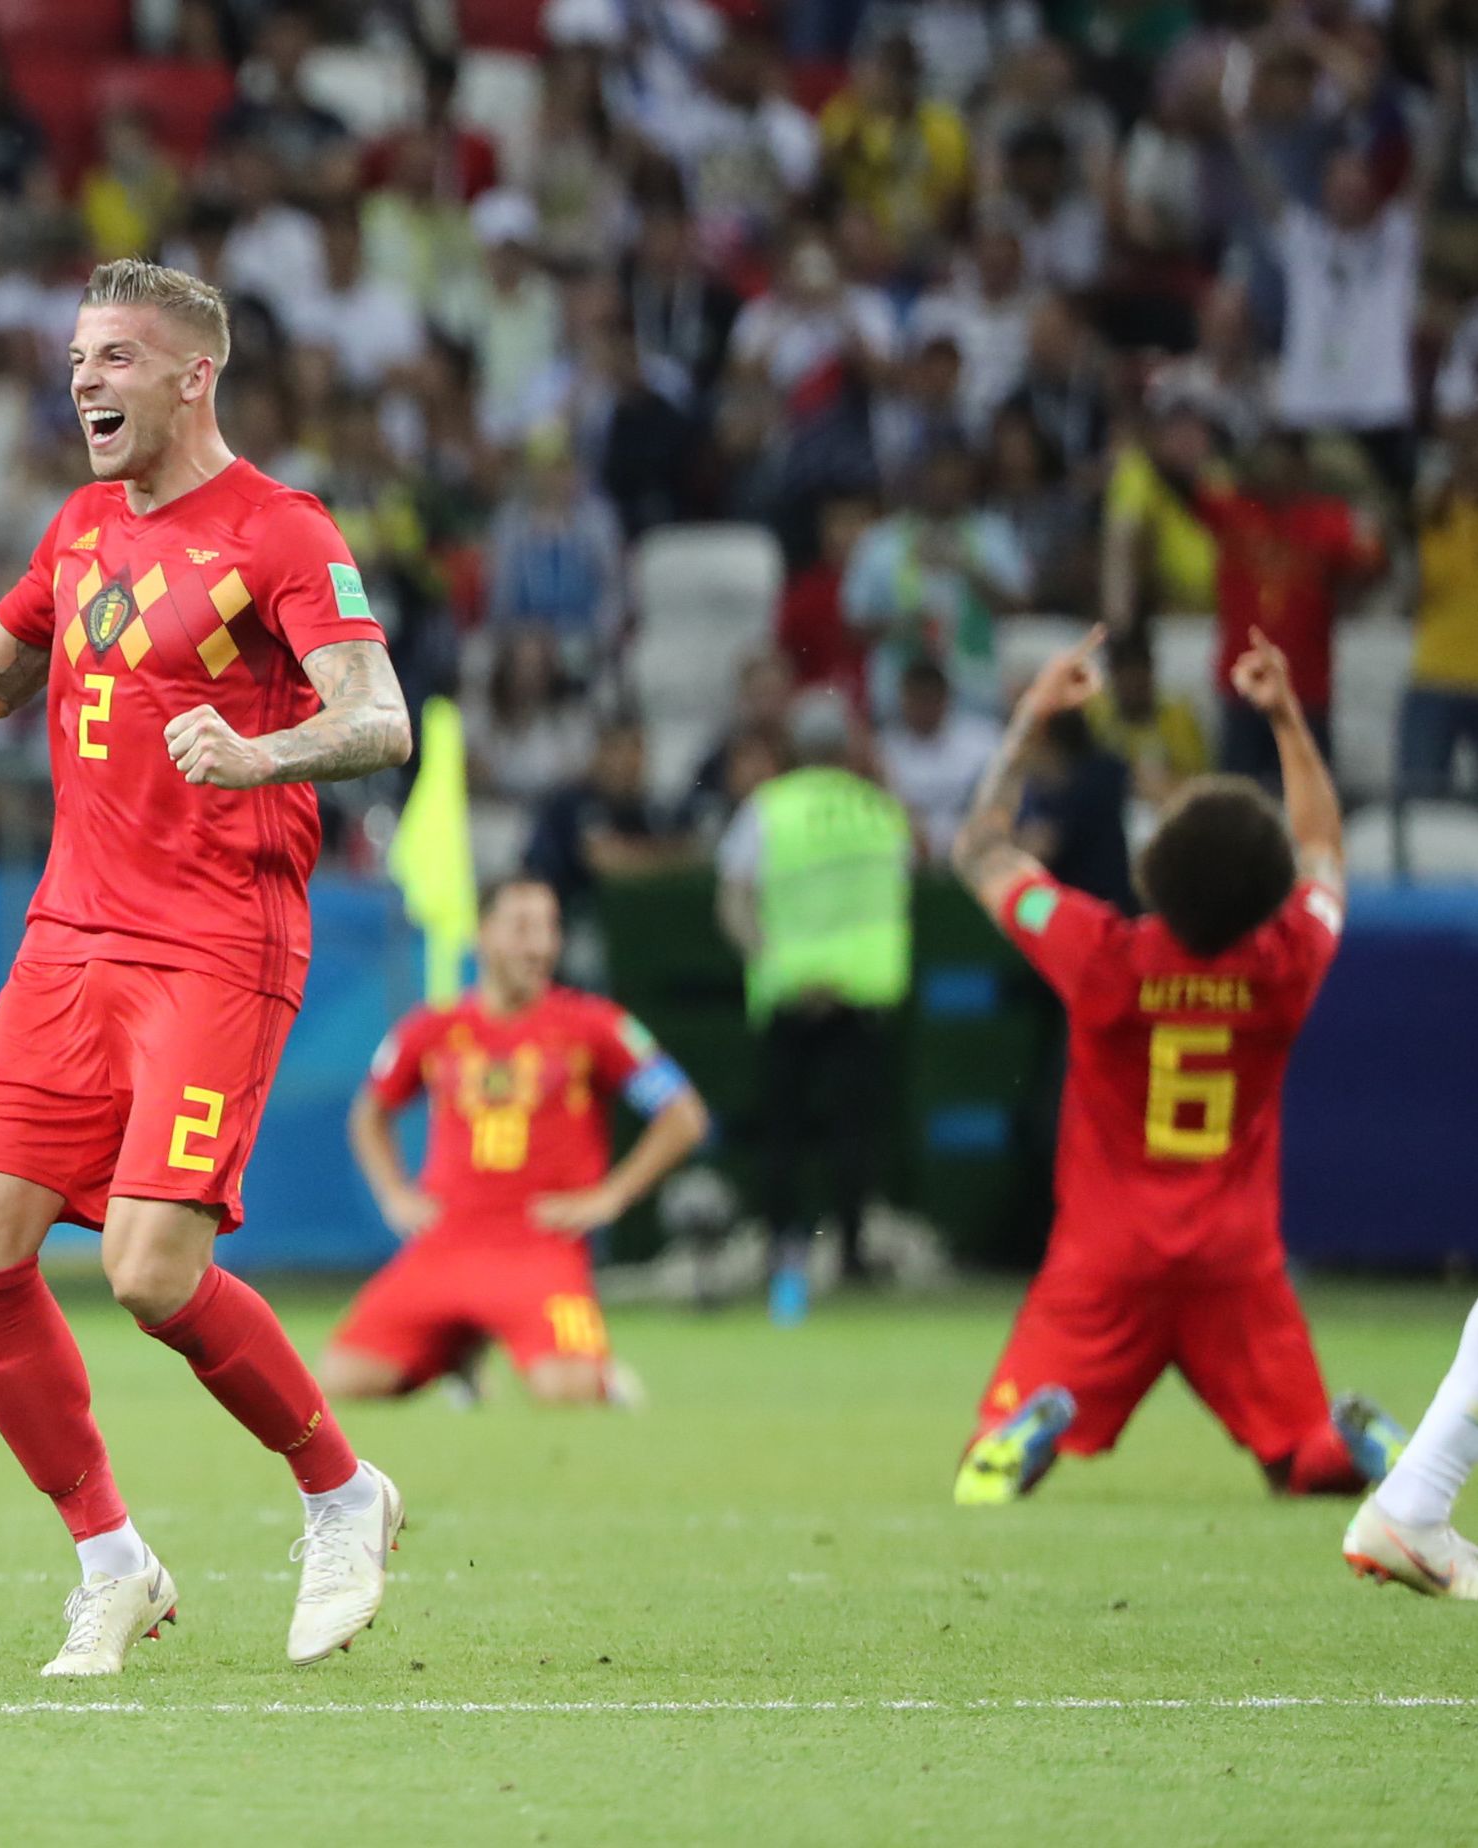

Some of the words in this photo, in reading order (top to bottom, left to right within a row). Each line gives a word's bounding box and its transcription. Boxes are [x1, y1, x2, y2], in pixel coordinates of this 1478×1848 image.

[78, 673, 116, 760] 2
[167, 1085, 225, 1173] 2
[1145, 1023, 1236, 1160] 6
